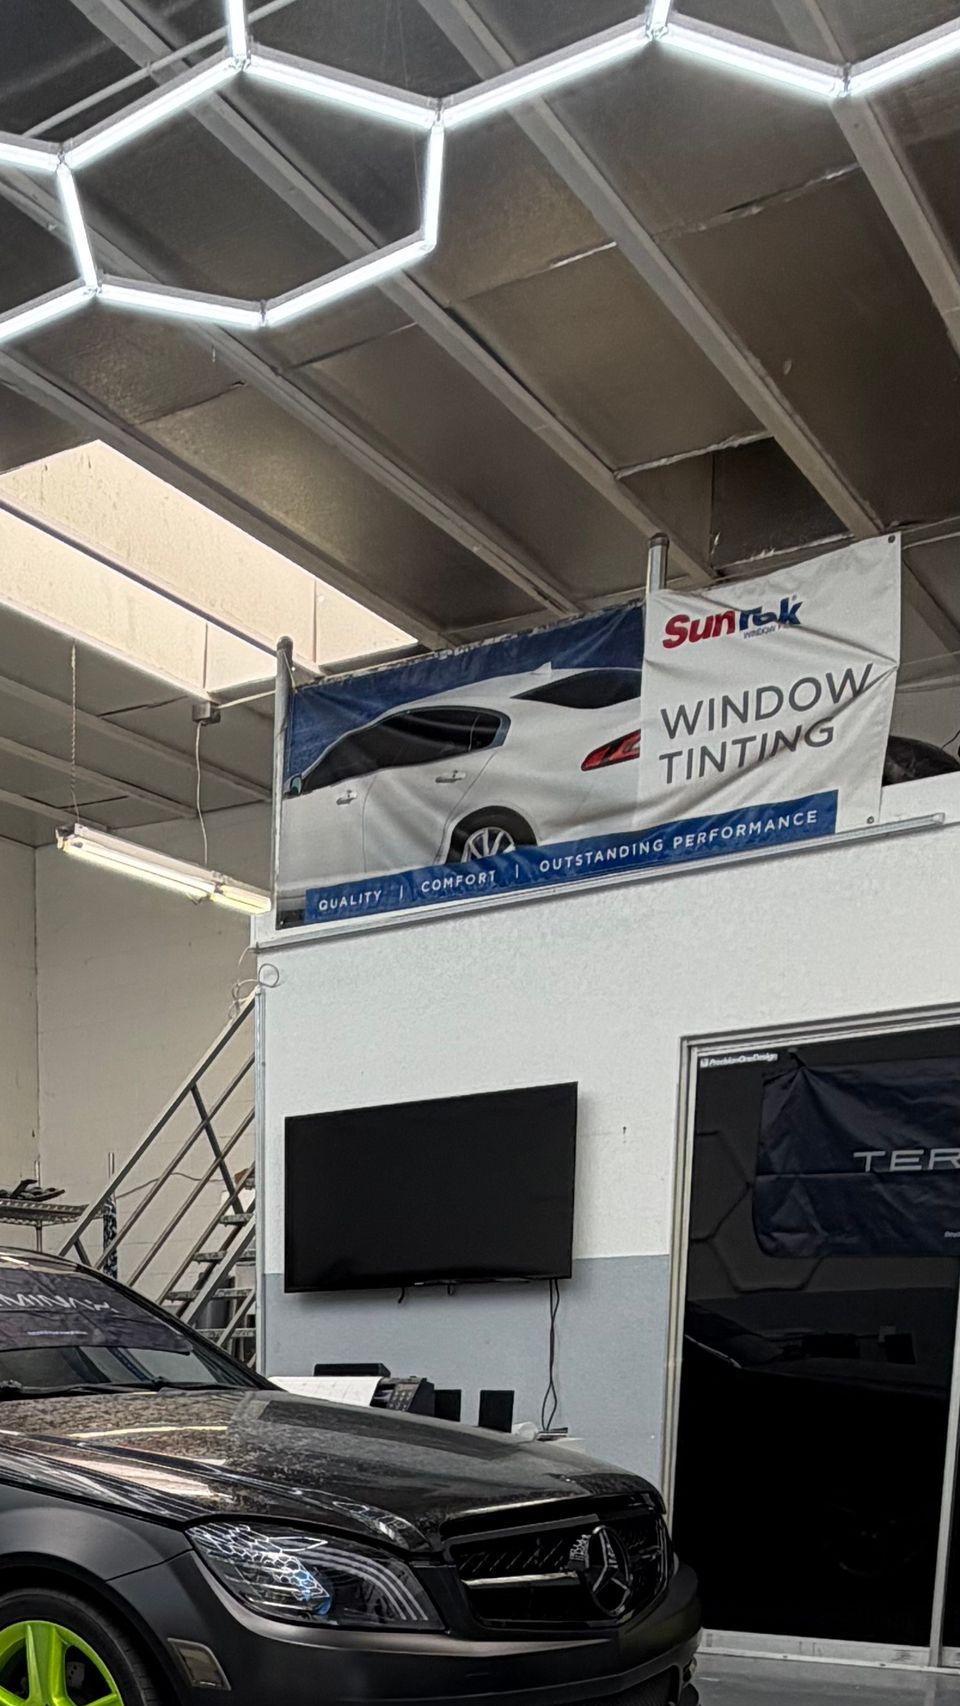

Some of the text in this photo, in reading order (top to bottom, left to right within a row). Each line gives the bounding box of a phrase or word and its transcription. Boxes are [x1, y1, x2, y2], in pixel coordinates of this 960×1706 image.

[660, 663, 873, 739] WINDOW
[659, 715, 835, 784] TINTING
[318, 810, 817, 911] QUALITY COMFORT OUTSTANDING PERFORMANCE
